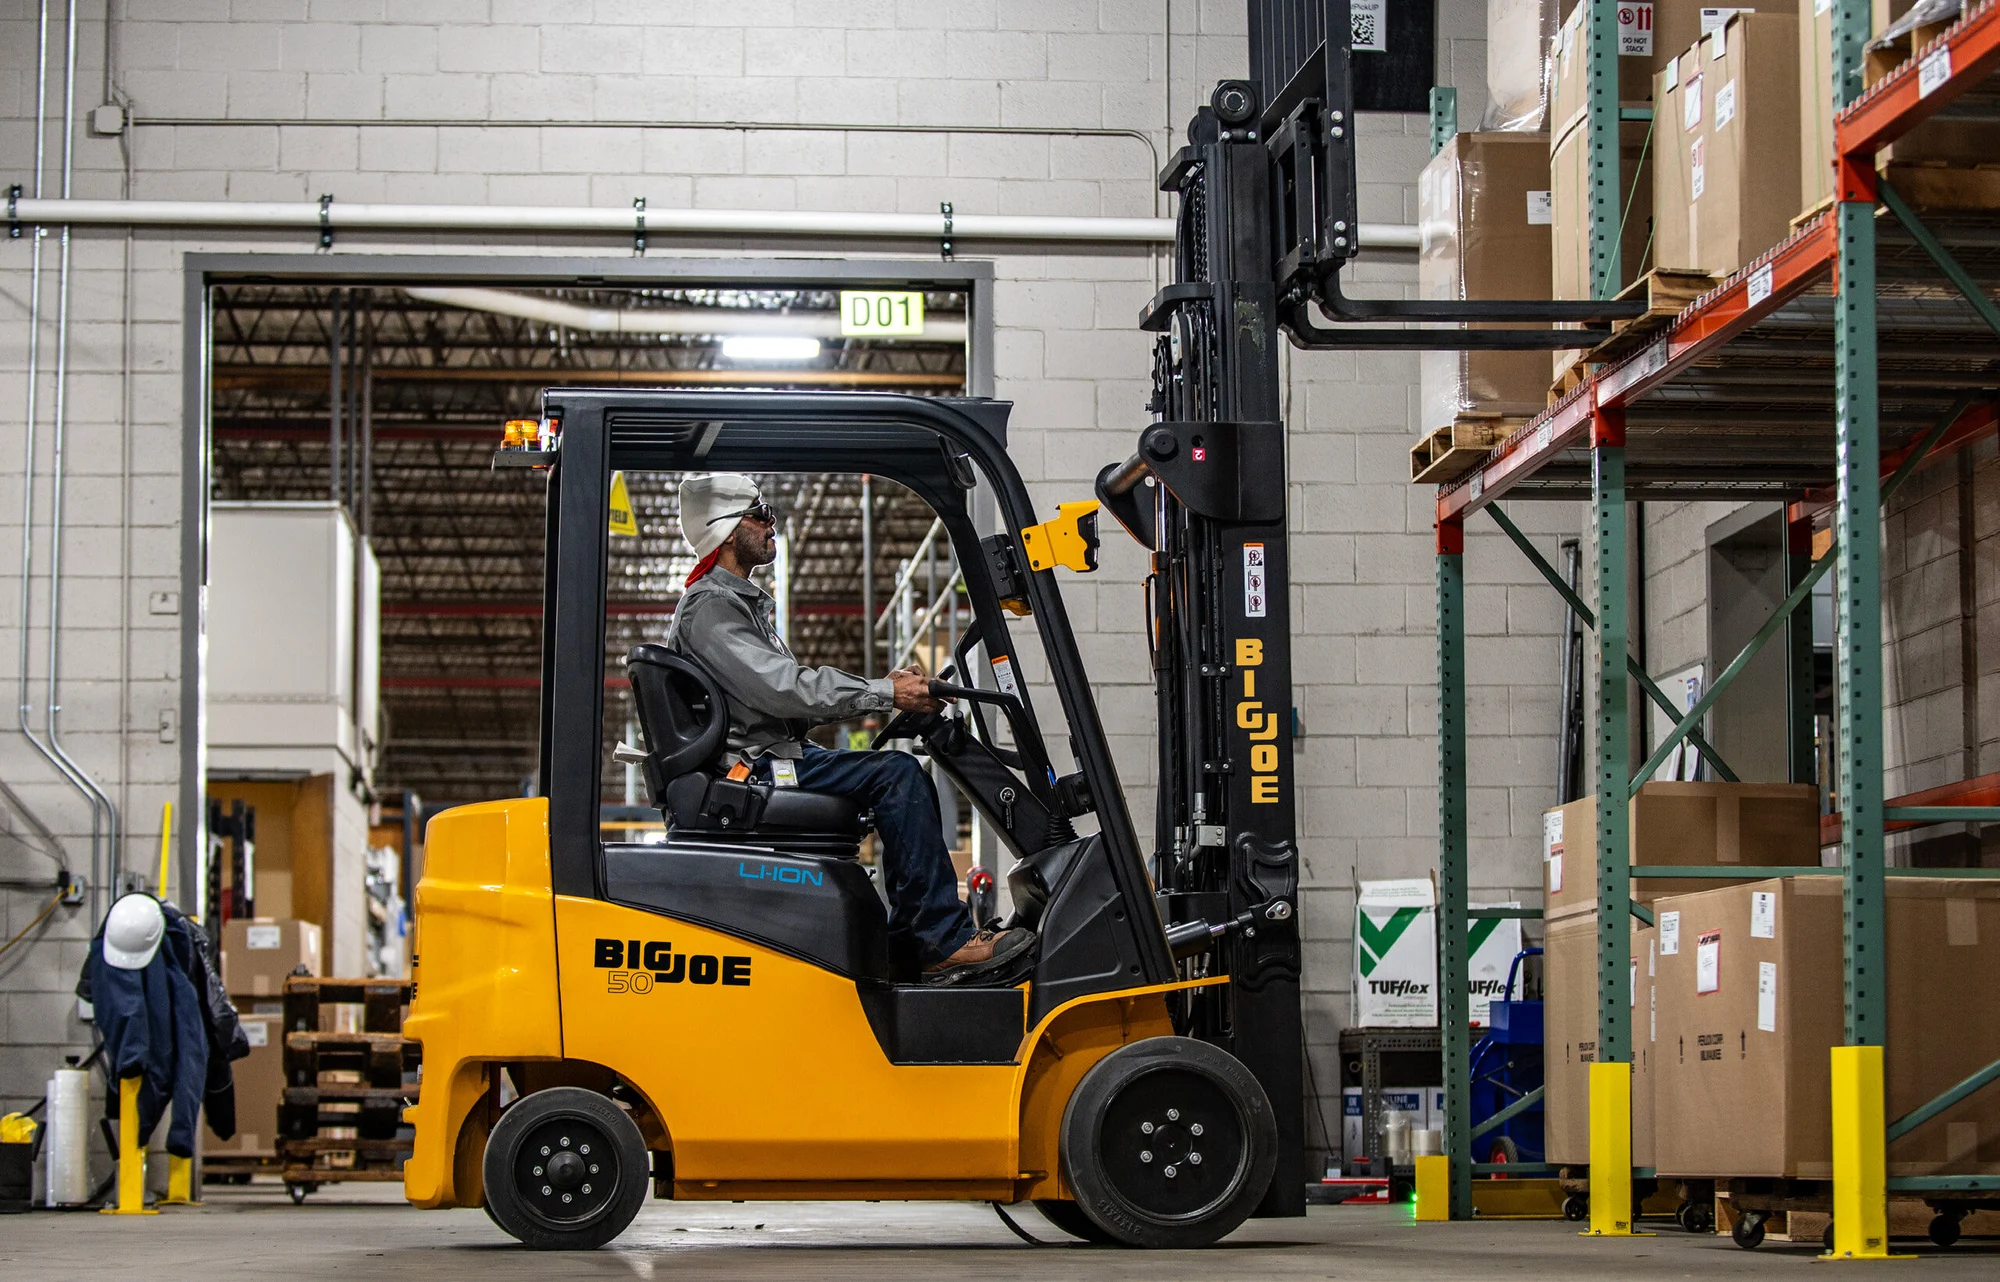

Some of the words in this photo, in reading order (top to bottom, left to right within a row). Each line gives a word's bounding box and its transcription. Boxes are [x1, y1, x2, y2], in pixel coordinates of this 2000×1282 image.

[852, 295, 910, 327] D01
[738, 861, 823, 887] LI-ION
[607, 970, 654, 995] 50
[1368, 980, 1431, 997] TUFflex
